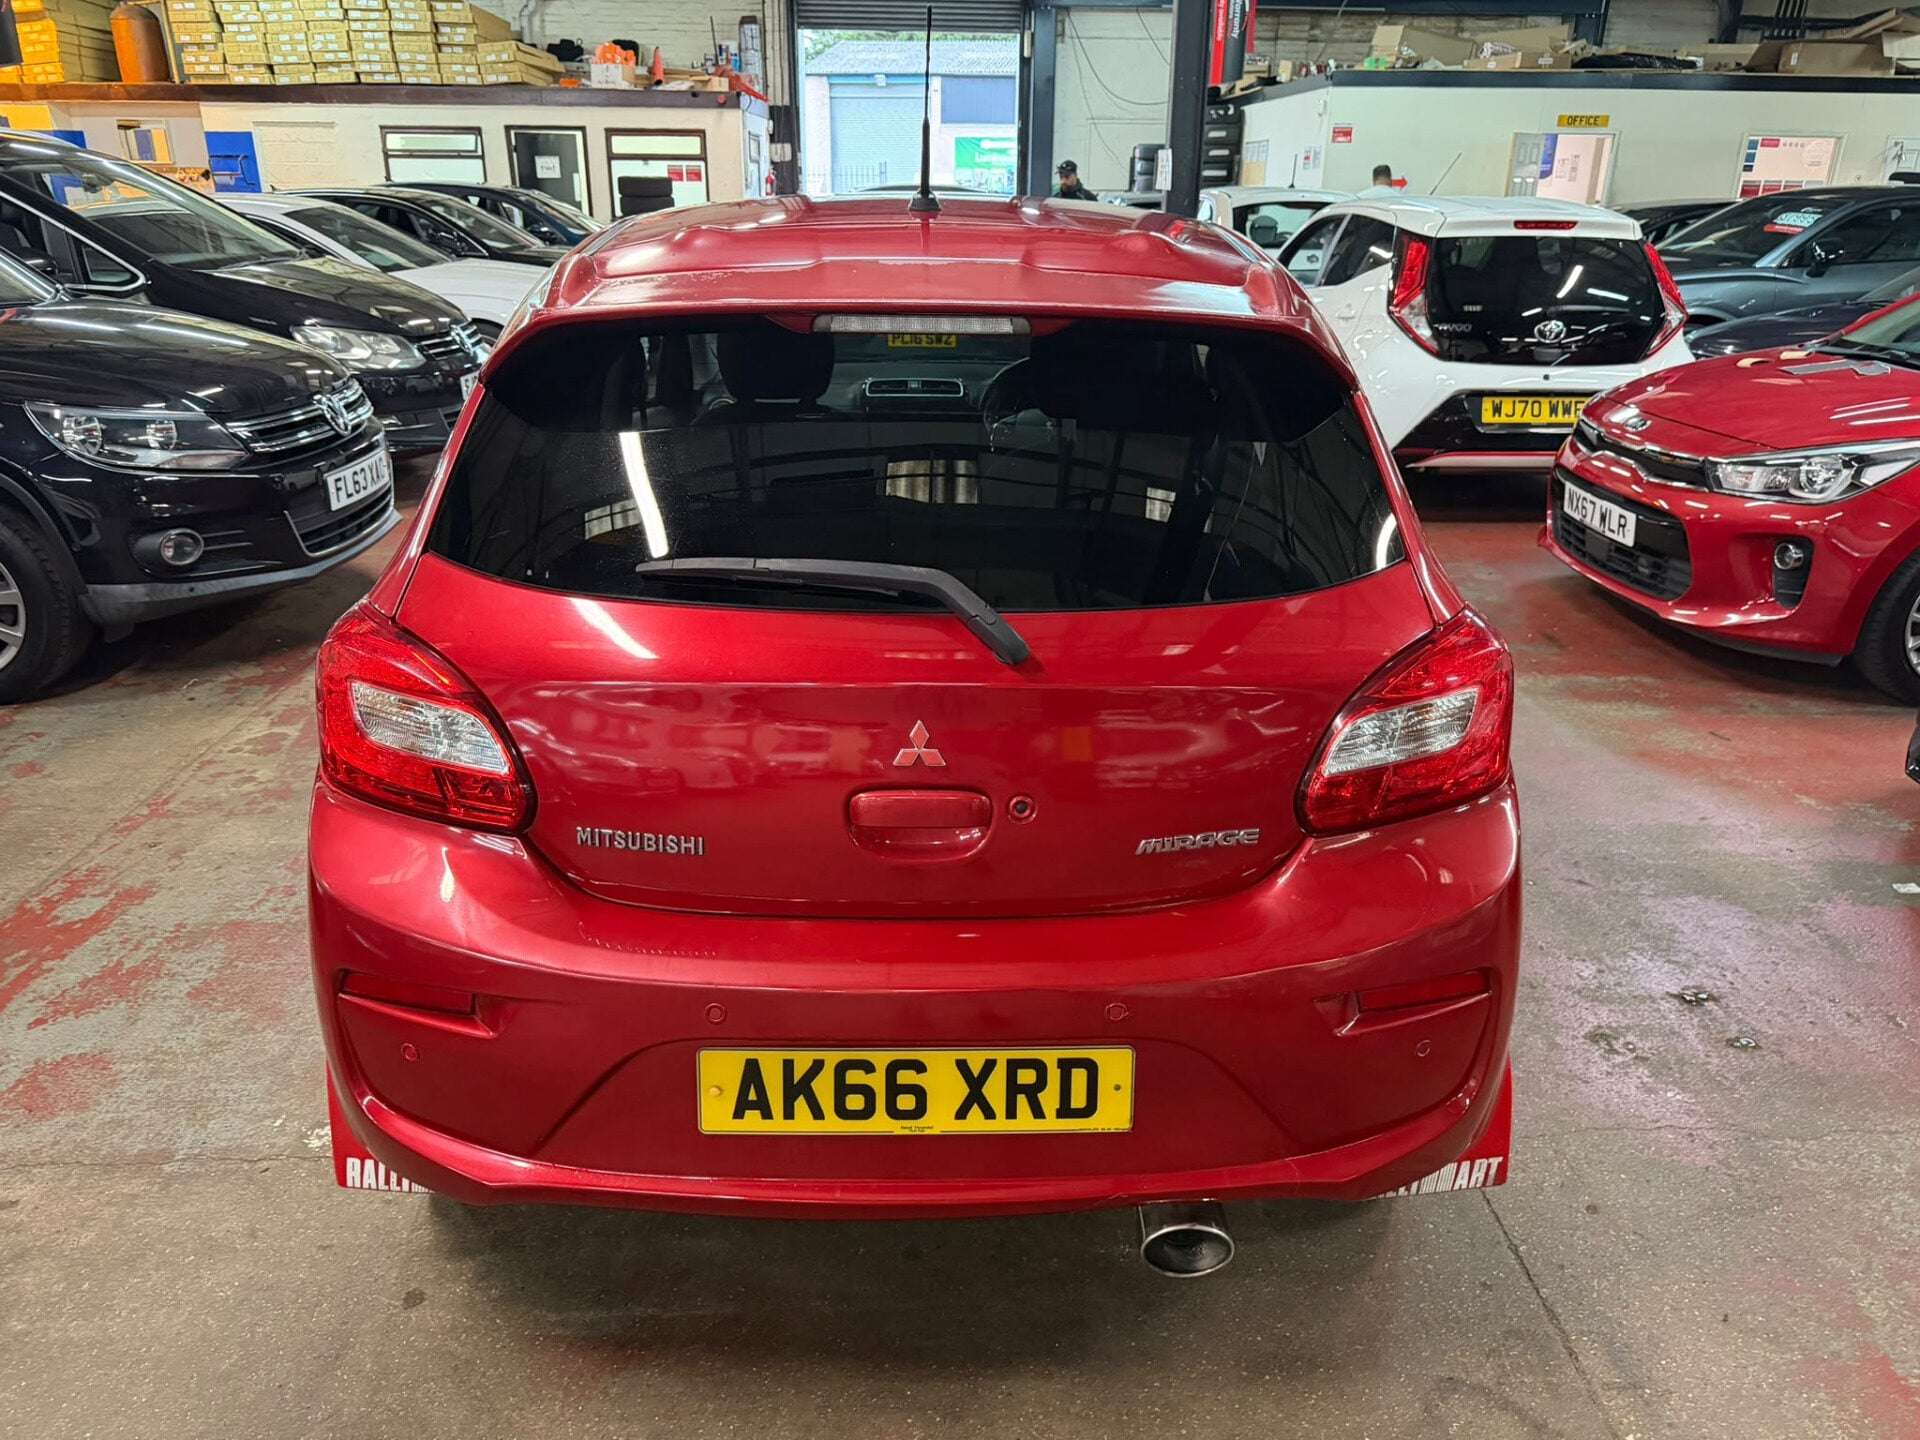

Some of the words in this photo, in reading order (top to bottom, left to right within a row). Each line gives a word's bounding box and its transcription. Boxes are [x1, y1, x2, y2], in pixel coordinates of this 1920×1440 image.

[1566, 115, 1600, 126] OFFICE
[1492, 400, 1541, 418] WJ70
[334, 467, 368, 503] FL63
[1568, 487, 1596, 523] NX67
[1599, 504, 1627, 538] WLR
[576, 826, 705, 856] MITSUBISHI
[1135, 828, 1260, 856] MIRAGE
[731, 1058, 928, 1121] AK66
[953, 1057, 1099, 1121] XRD
